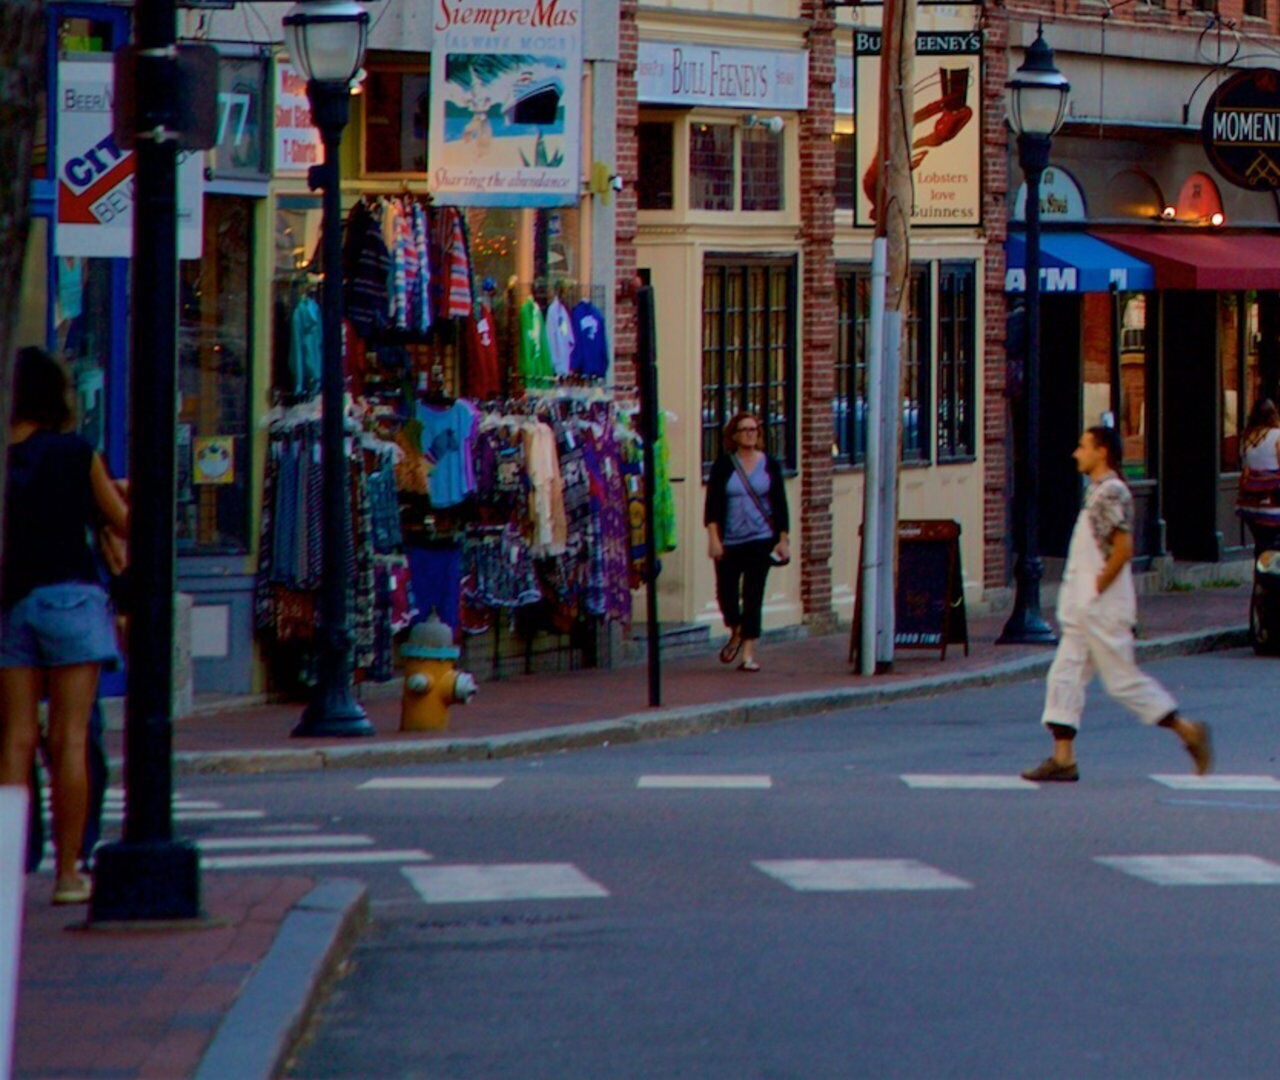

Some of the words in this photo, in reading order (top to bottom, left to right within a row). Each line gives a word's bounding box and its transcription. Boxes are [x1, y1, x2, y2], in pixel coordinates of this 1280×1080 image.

[916, 33, 981, 51] EENEY'S
[672, 47, 707, 95] BULL
[918, 172, 969, 184] Lobsters
[931, 189, 956, 200] love
